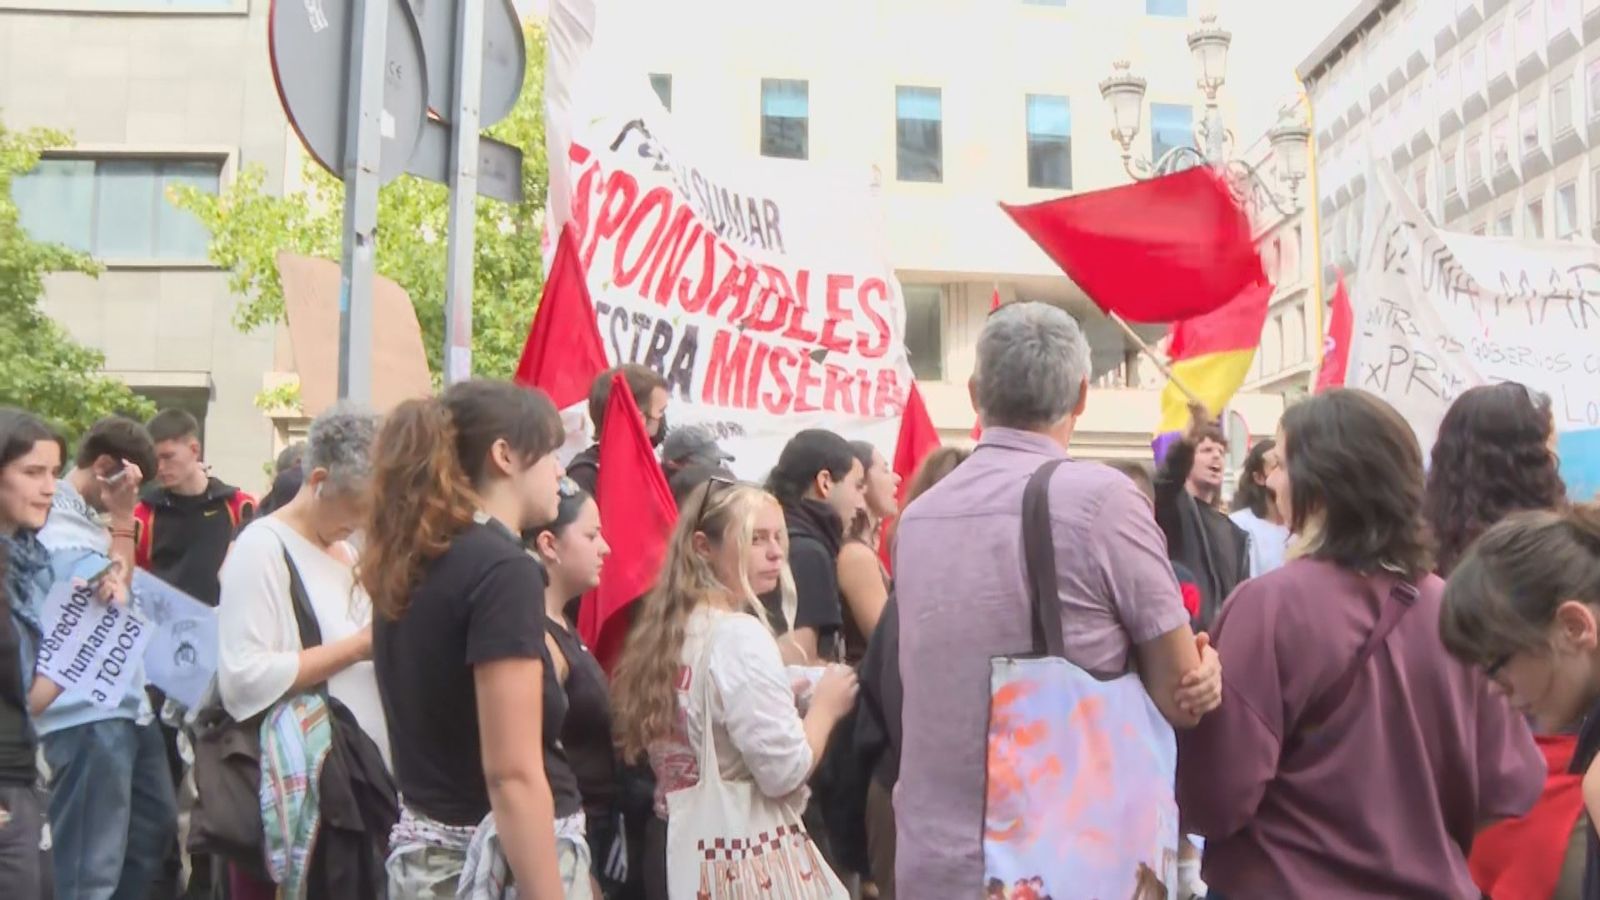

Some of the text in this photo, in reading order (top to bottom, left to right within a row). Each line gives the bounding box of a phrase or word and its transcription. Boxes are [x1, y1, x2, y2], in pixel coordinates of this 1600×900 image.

[701, 329, 906, 418] MISERIA
[58, 605, 121, 684] humanos
[91, 688, 108, 704] a
